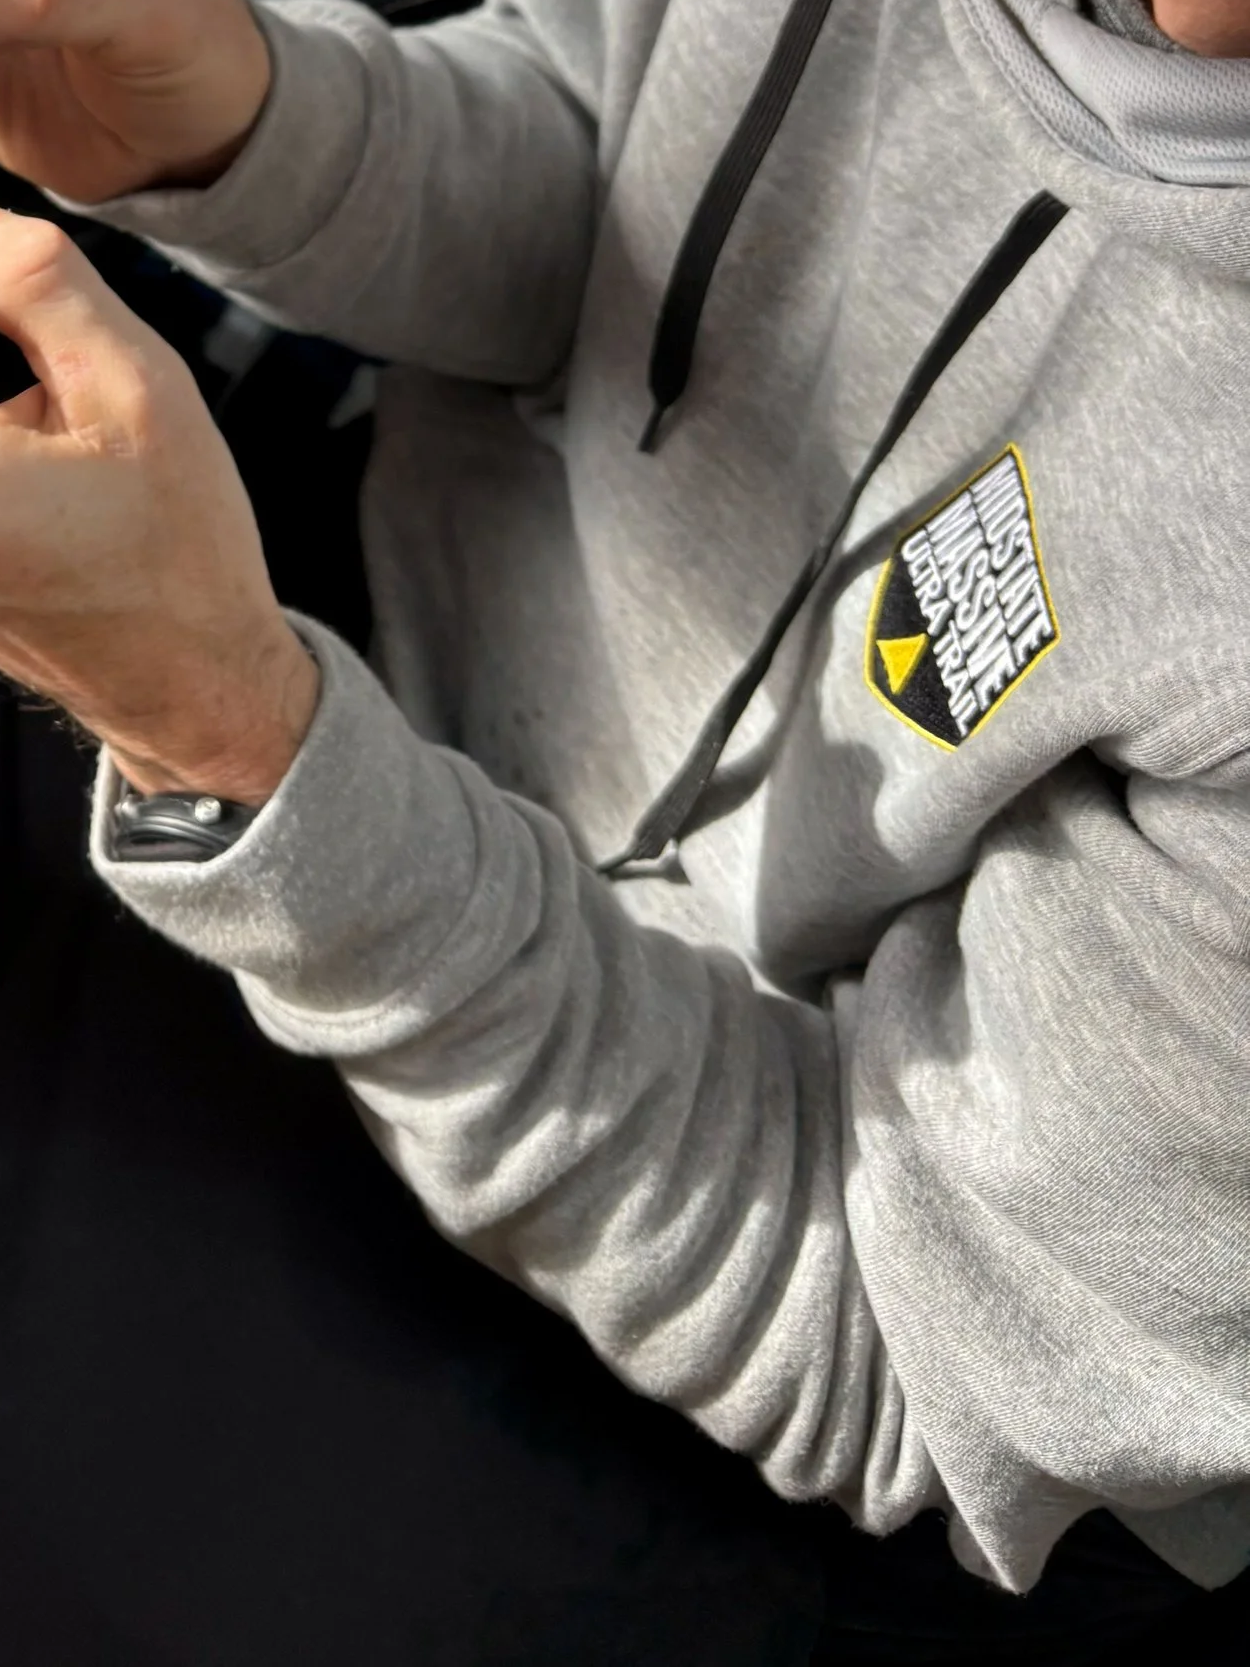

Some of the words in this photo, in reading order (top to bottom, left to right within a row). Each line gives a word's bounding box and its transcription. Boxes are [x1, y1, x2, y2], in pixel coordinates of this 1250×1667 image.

[901, 528, 950, 635] ULTRA
[933, 620, 979, 736] TRAIL
[926, 492, 1017, 711] MASSIVE
[969, 455, 1052, 665] MIDSTATE
